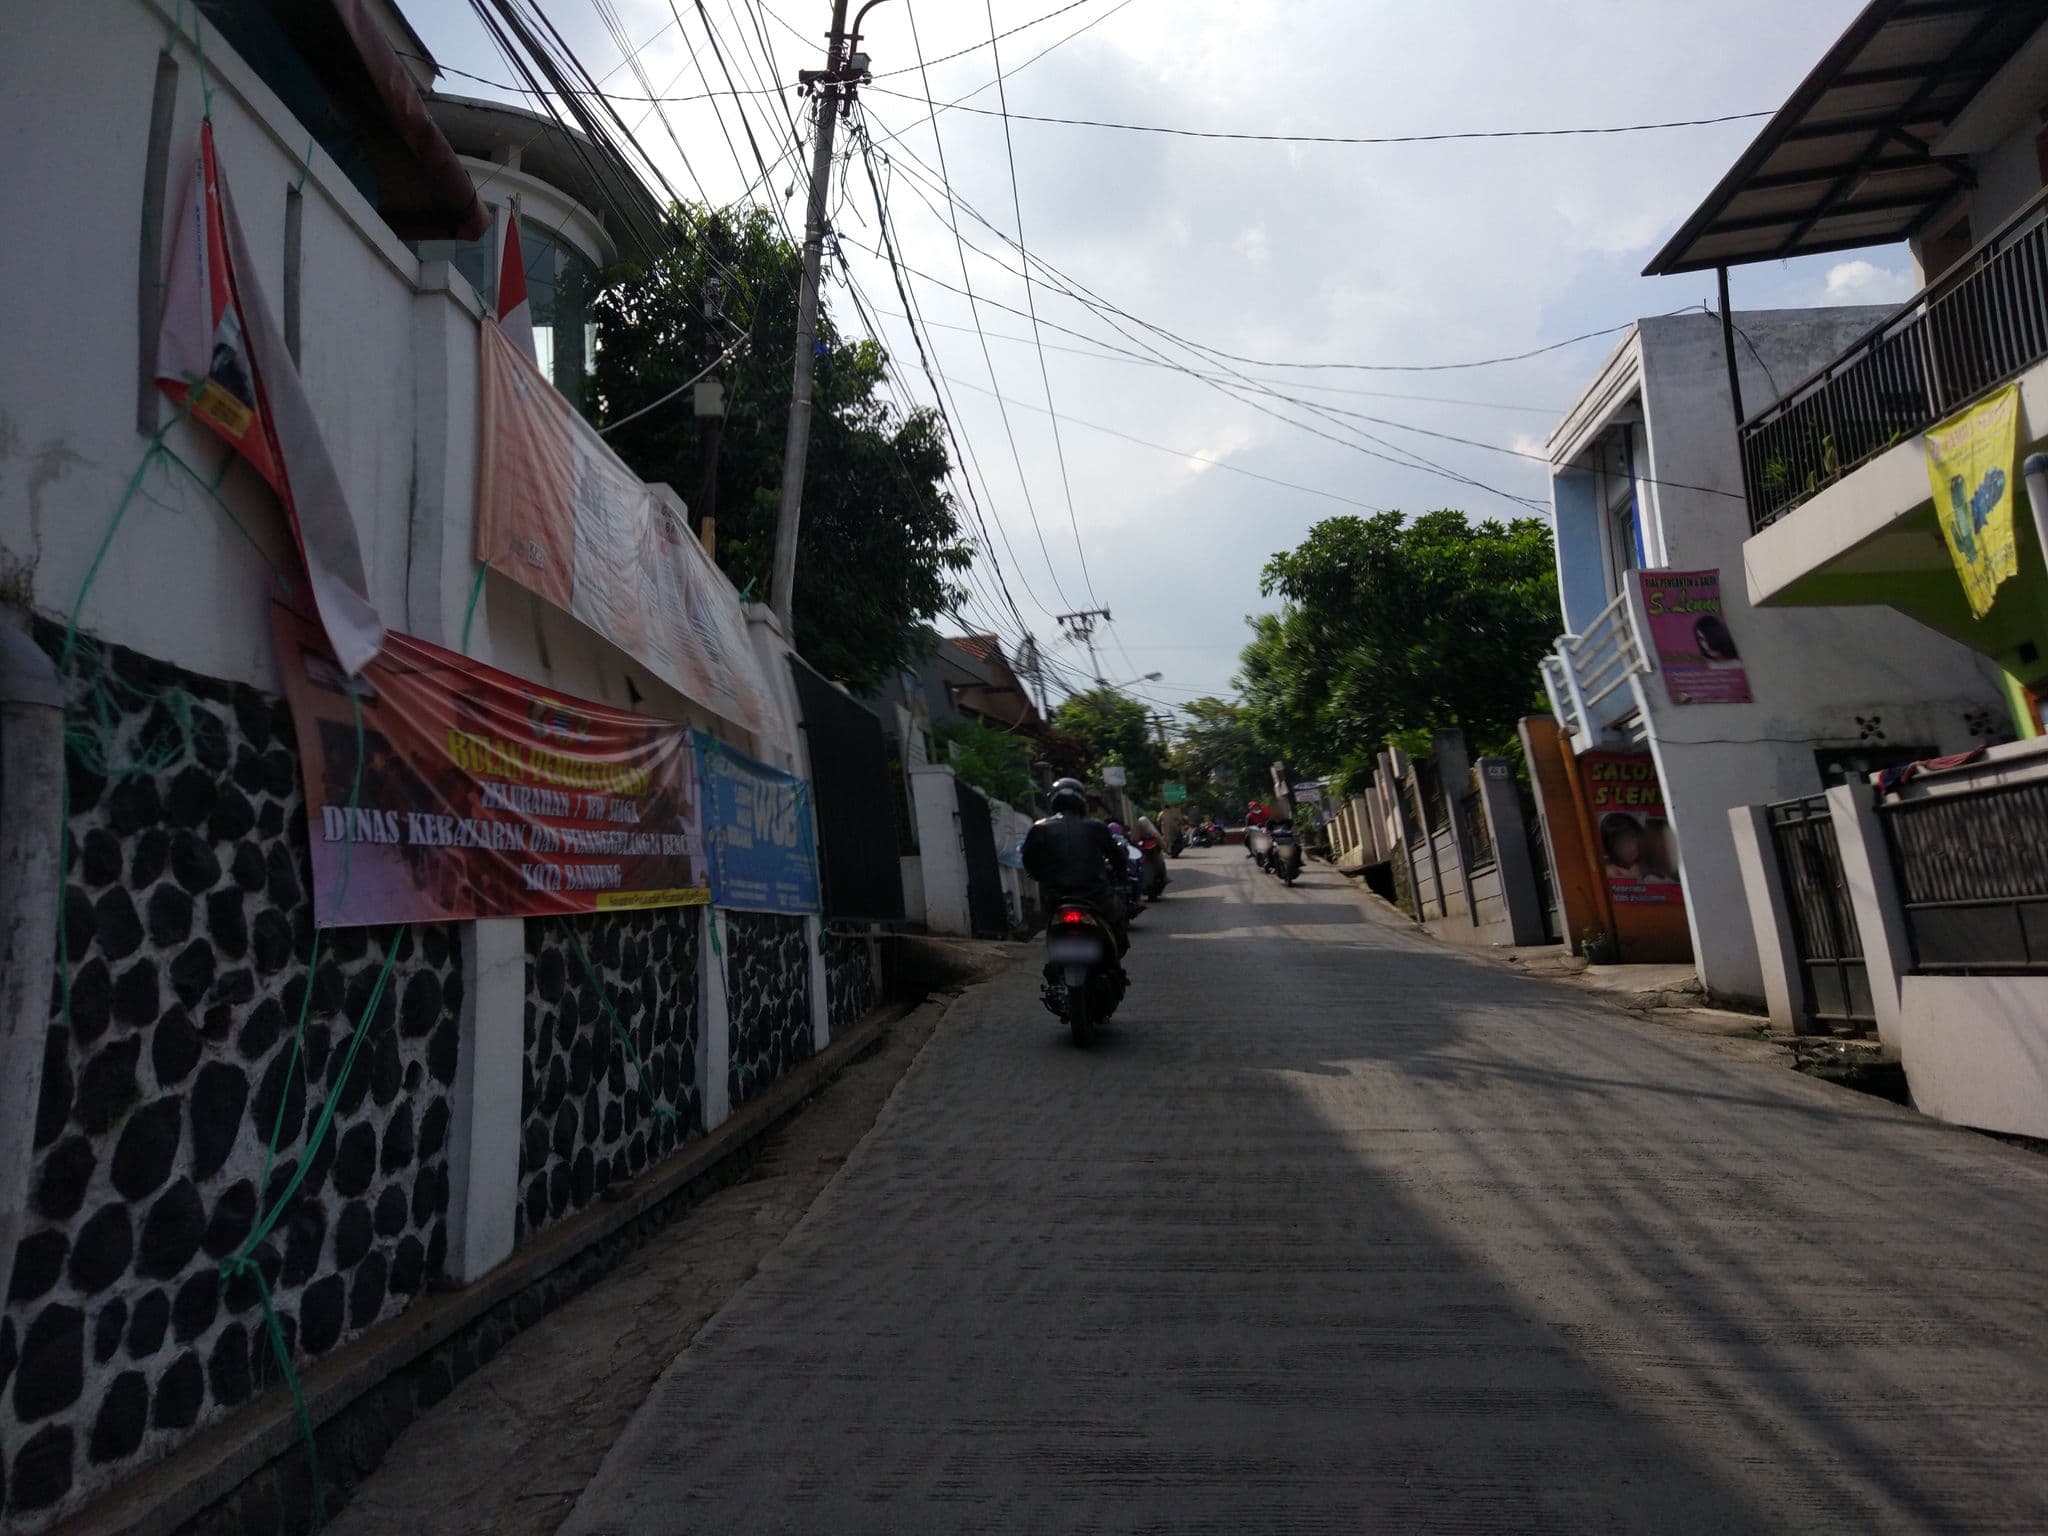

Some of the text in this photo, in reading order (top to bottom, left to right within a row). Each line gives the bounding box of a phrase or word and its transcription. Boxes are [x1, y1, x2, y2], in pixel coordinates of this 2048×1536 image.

[447, 728, 525, 779] BULAN
[321, 805, 400, 845] DINAS
[407, 811, 526, 852] KEBAKARAN
[531, 824, 560, 853] DAN
[521, 863, 622, 891] KOTA BANDUNG
